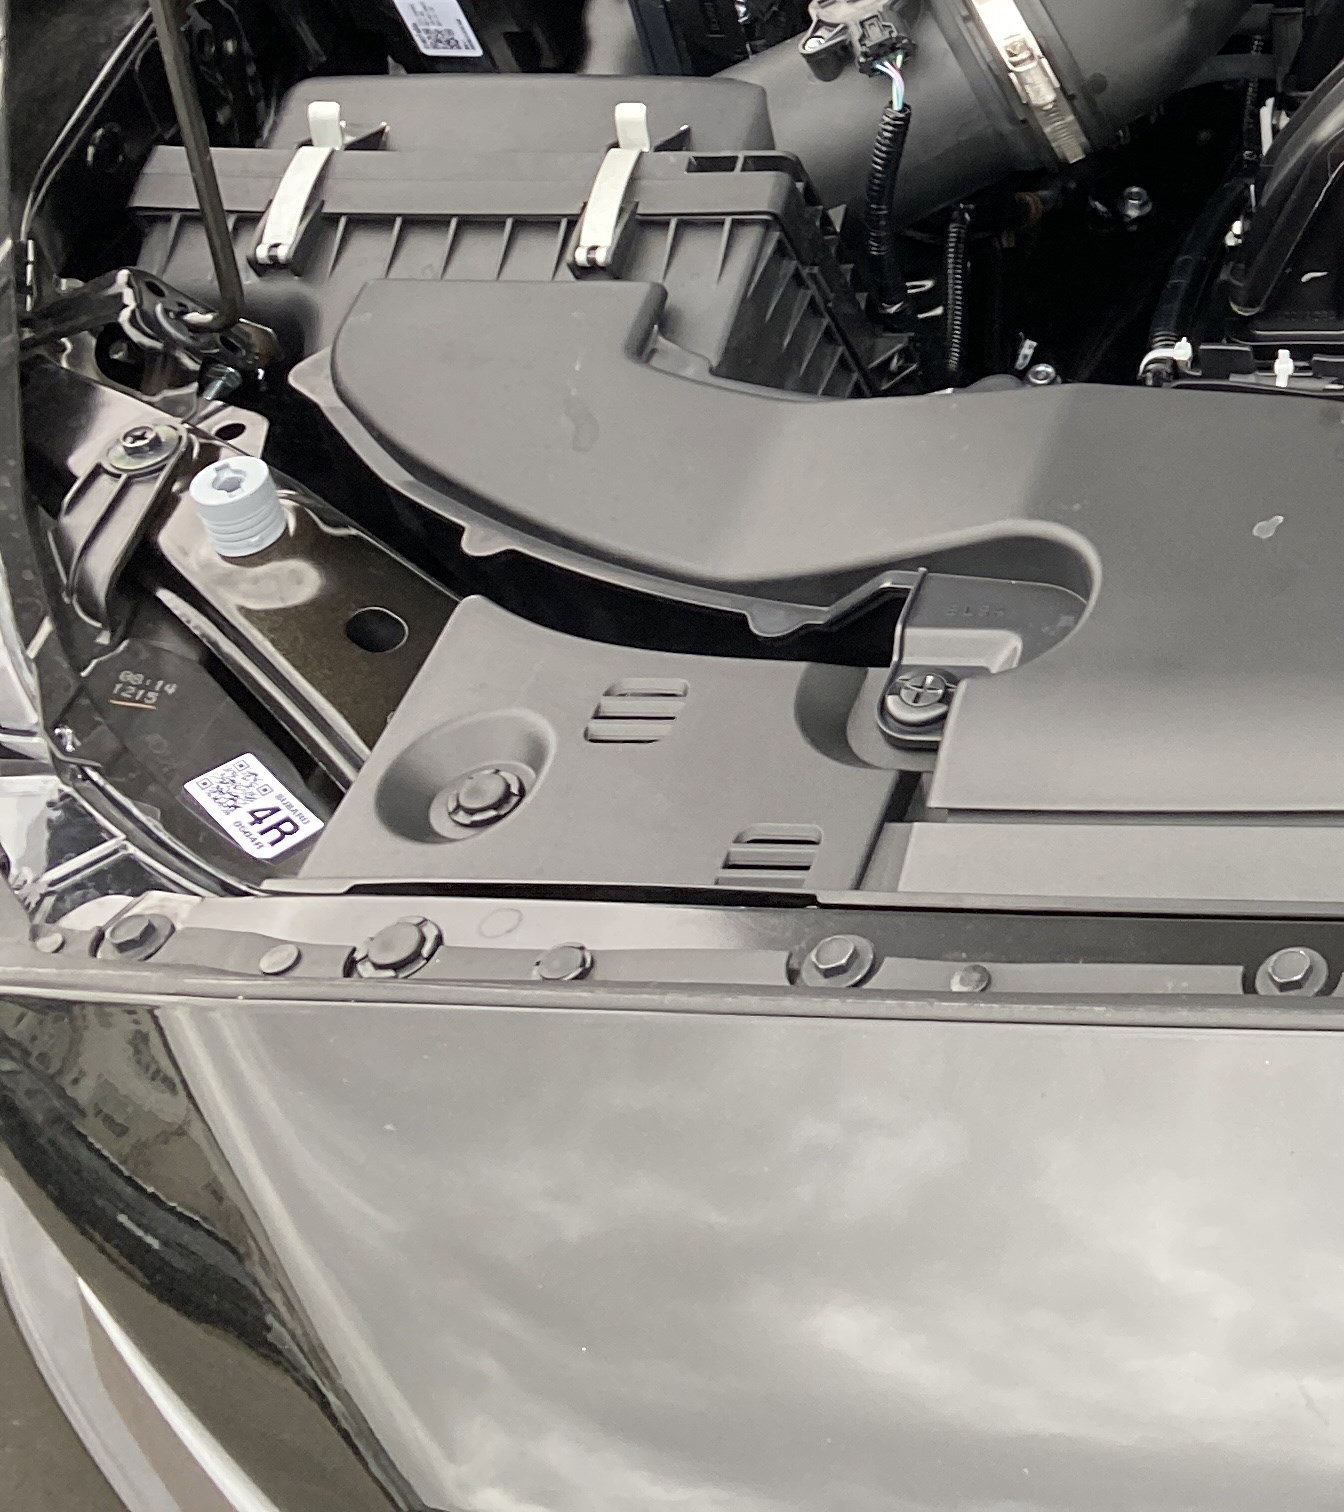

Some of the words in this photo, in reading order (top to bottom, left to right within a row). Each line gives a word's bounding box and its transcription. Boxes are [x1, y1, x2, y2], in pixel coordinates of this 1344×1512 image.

[112, 683, 159, 704] 1215
[275, 793, 310, 825] SUBARU
[247, 805, 300, 847] 4R
